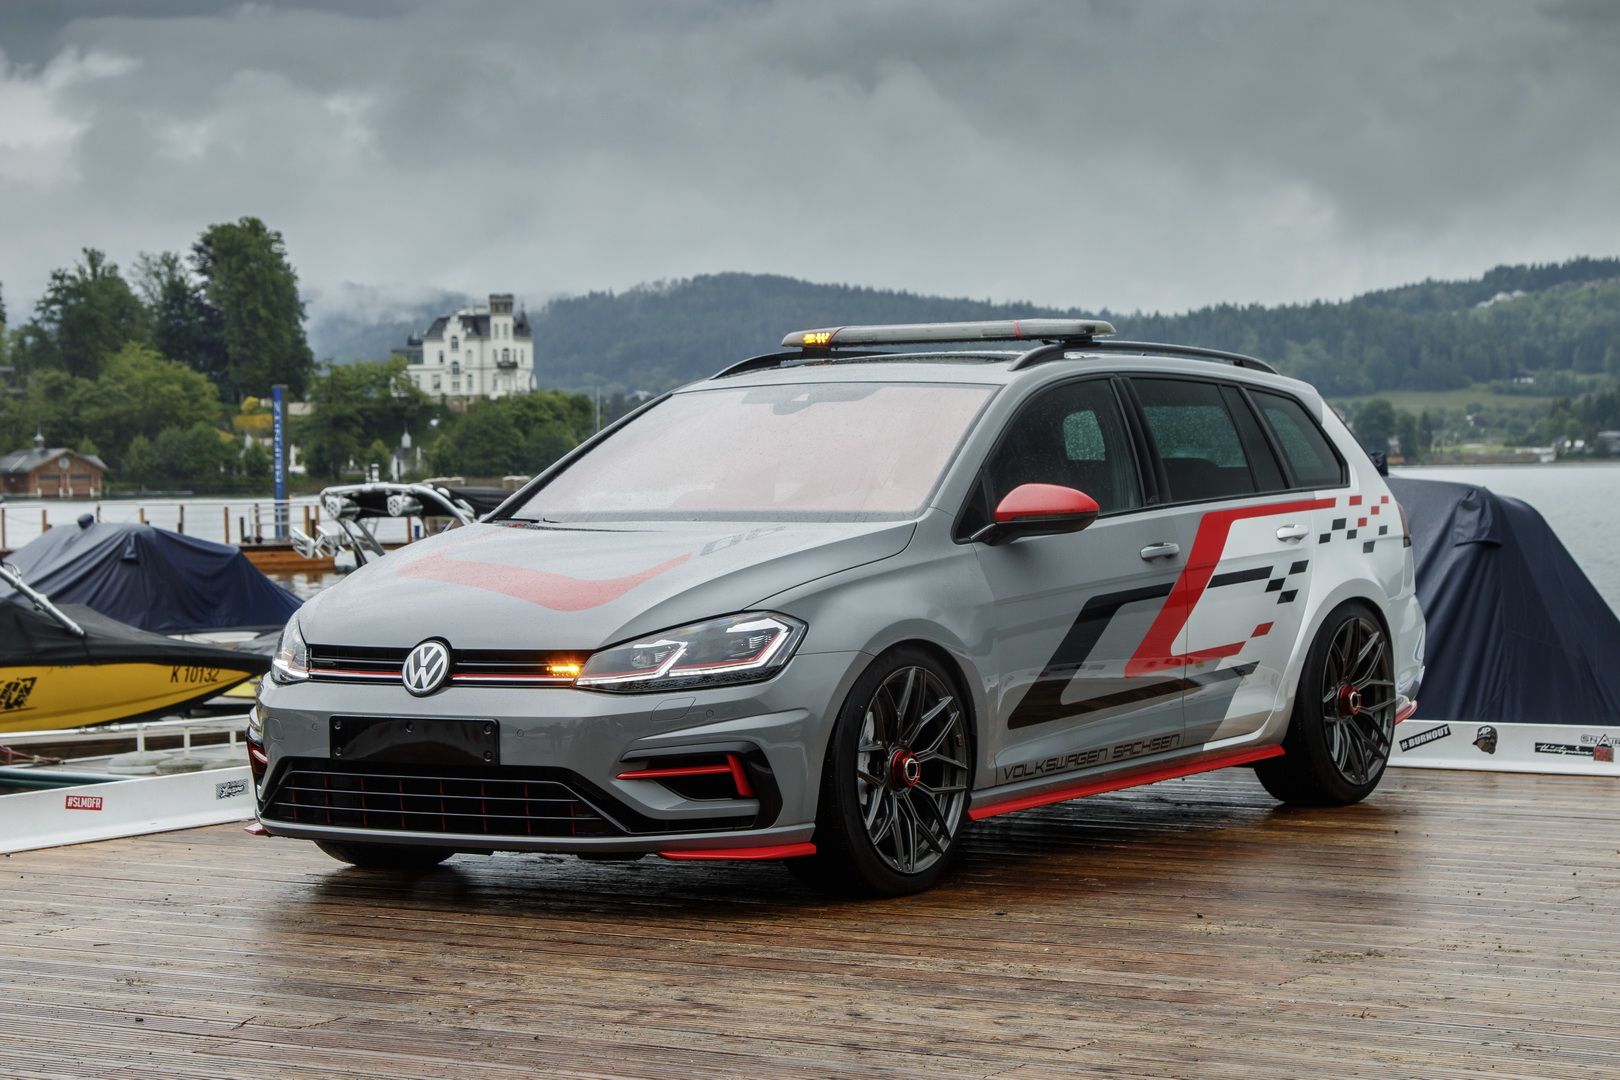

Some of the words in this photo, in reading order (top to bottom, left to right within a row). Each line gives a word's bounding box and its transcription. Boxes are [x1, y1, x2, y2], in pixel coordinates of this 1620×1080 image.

[170, 665, 180, 683] K
[184, 665, 219, 683] 10132
[1401, 725, 1450, 750] #BURNOUT
[1003, 748, 1108, 780] VOLKSWAGEN
[1112, 733, 1181, 758] SACHSEN
[67, 797, 101, 809] #SLMDFR
